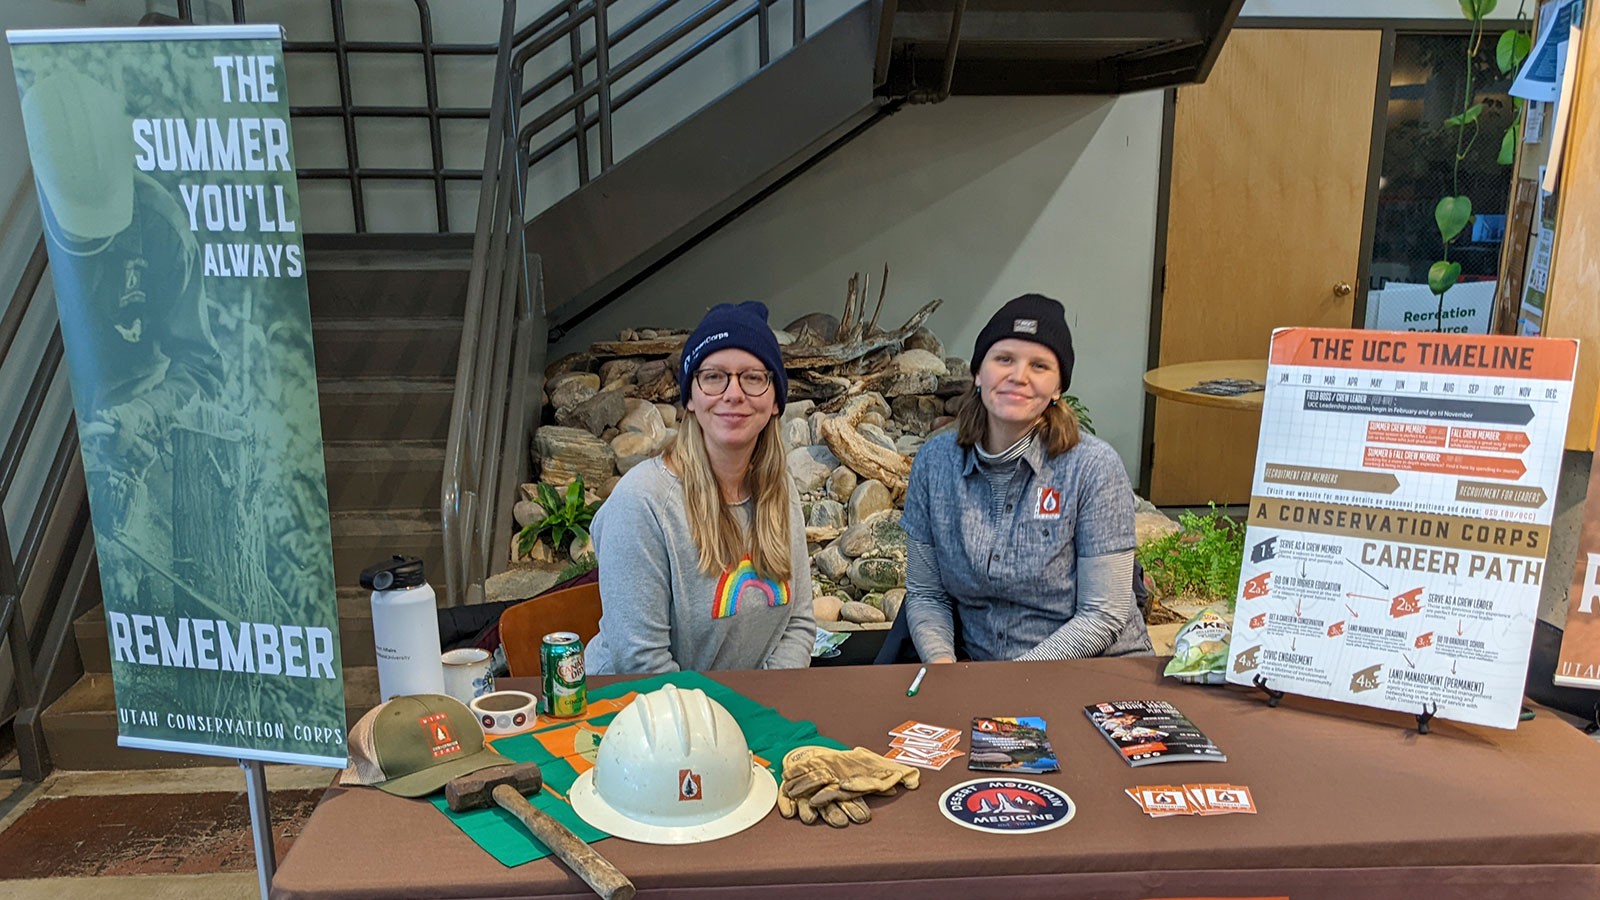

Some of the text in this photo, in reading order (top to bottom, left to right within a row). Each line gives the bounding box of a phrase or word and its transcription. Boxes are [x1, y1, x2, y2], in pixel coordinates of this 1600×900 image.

[213, 55, 279, 103] THE
[132, 118, 292, 171] SUMMER
[179, 184, 296, 233] YOU'LL
[203, 243, 303, 278] ALWAYS
[1403, 307, 1476, 322] Recreation
[1310, 337, 1535, 371] THE UCC TIMELINE
[1280, 373, 1558, 399] JAN FEB MAR APR MAY JUN JUL AUG SEP OCT NOV DEC
[1306, 391, 1319, 400] FIELD
[1336, 393, 1349, 403] CREW
[1350, 394, 1367, 404] LEADER
[1319, 403, 1347, 411] Leadership
[1348, 404, 1370, 412] positions
[1371, 405, 1387, 414] begin
[1394, 408, 1417, 416] February
[1444, 411, 1473, 419] November
[1370, 422, 1390, 431] SUMMER
[1391, 423, 1404, 433] CREW
[1405, 424, 1426, 434] MEMBER
[1451, 428, 1462, 438] FALL
[1463, 429, 1477, 439] CREW
[1478, 430, 1500, 441] MEMBER
[1367, 448, 1388, 458] SUMMER
[1393, 450, 1403, 459] FALL
[1404, 451, 1418, 460] CREW
[1419, 452, 1440, 462] MEMBER
[1265, 467, 1339, 484] RECRUITMENT FOR MEMBERS
[1298, 491, 1321, 499] website
[1351, 495, 1373, 504] details
[1385, 499, 1413, 508] seasonal
[1415, 502, 1445, 511] positions
[1447, 505, 1458, 513] and
[1459, 485, 1541, 503] RECRUITMENT FOR LEADERS
[1256, 503, 1540, 548] A CONSERVATION CORPS
[1280, 539, 1294, 549] SERVE
[1295, 541, 1301, 549] AS
[1306, 542, 1320, 552] CREW
[1321, 543, 1343, 554] MEMBER
[1361, 542, 1460, 575] CAREER
[1467, 553, 1543, 585] PATH
[1274, 575, 1341, 592] GO ON TO HIGHER EDUCATION
[1428, 593, 1444, 604] SERVE
[1445, 596, 1452, 605] AS
[1457, 597, 1473, 607] CREW
[1473, 599, 1494, 610] LEADER
[109, 611, 337, 680] REMEMBER
[1263, 649, 1313, 666] CIVIC ENGAGEMENT
[1388, 668, 1485, 695] LAND MANAGEMENT (PERMANENT)
[119, 707, 343, 745] UTAH CONSERVATION CORPS
[950, 782, 1064, 811] DESERT MOUNTAIN
[973, 813, 1055, 824] MEDICINE
